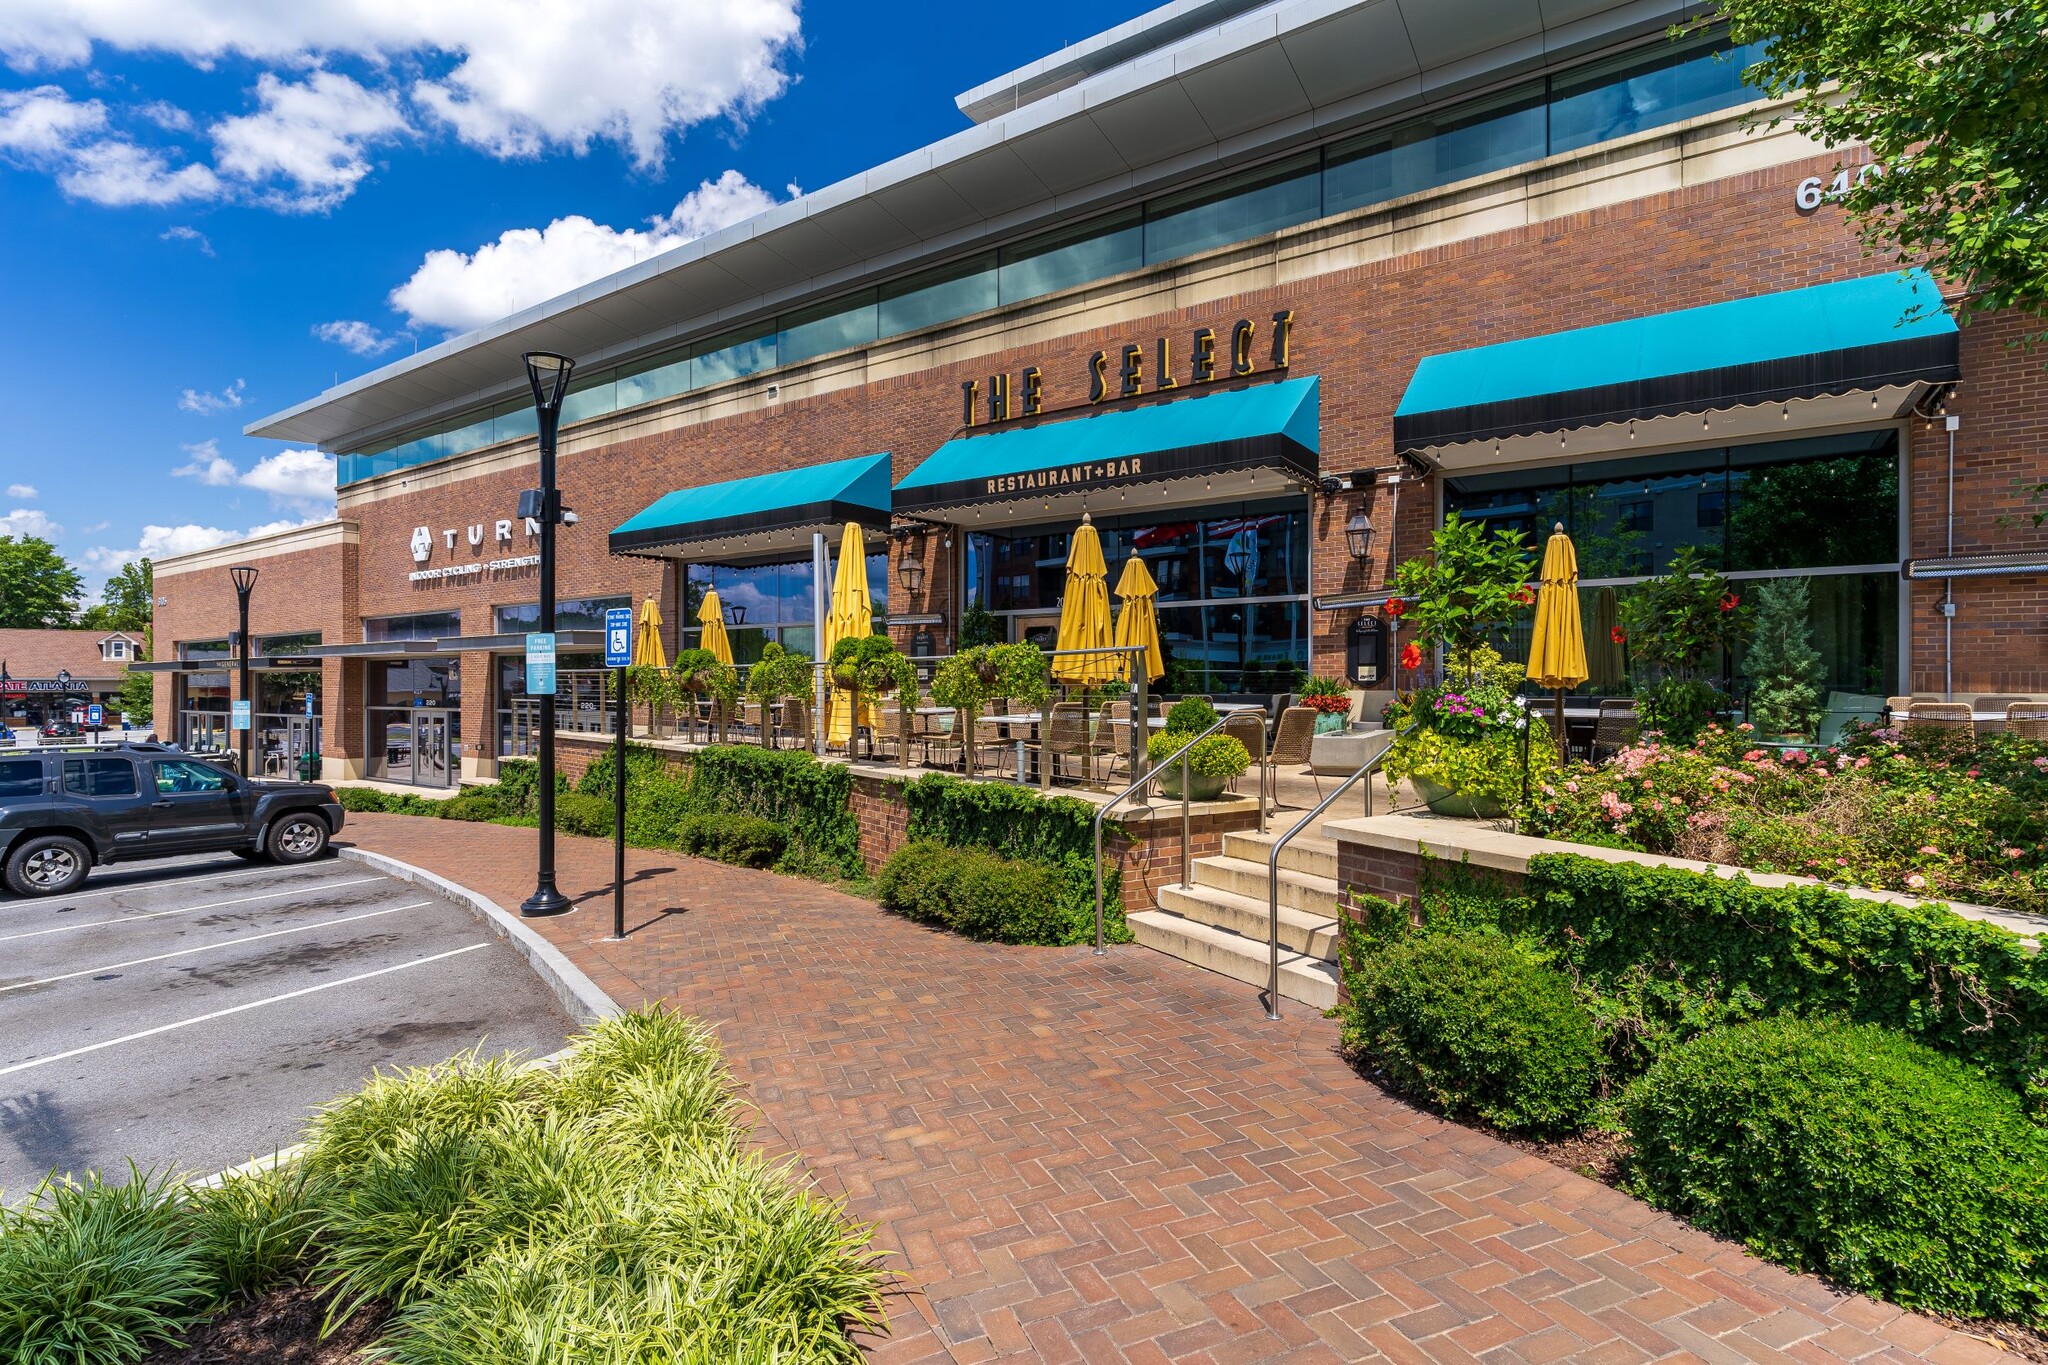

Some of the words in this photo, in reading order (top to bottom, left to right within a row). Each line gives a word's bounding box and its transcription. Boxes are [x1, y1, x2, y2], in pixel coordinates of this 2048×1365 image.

[962, 367, 1041, 428] THE
[1088, 310, 1294, 404] SELECT
[443, 517, 541, 549] TURN
[409, 569, 442, 581] INDOOR
[442, 563, 482, 577] CYCLING
[28, 681, 89, 691] ATLANTA
